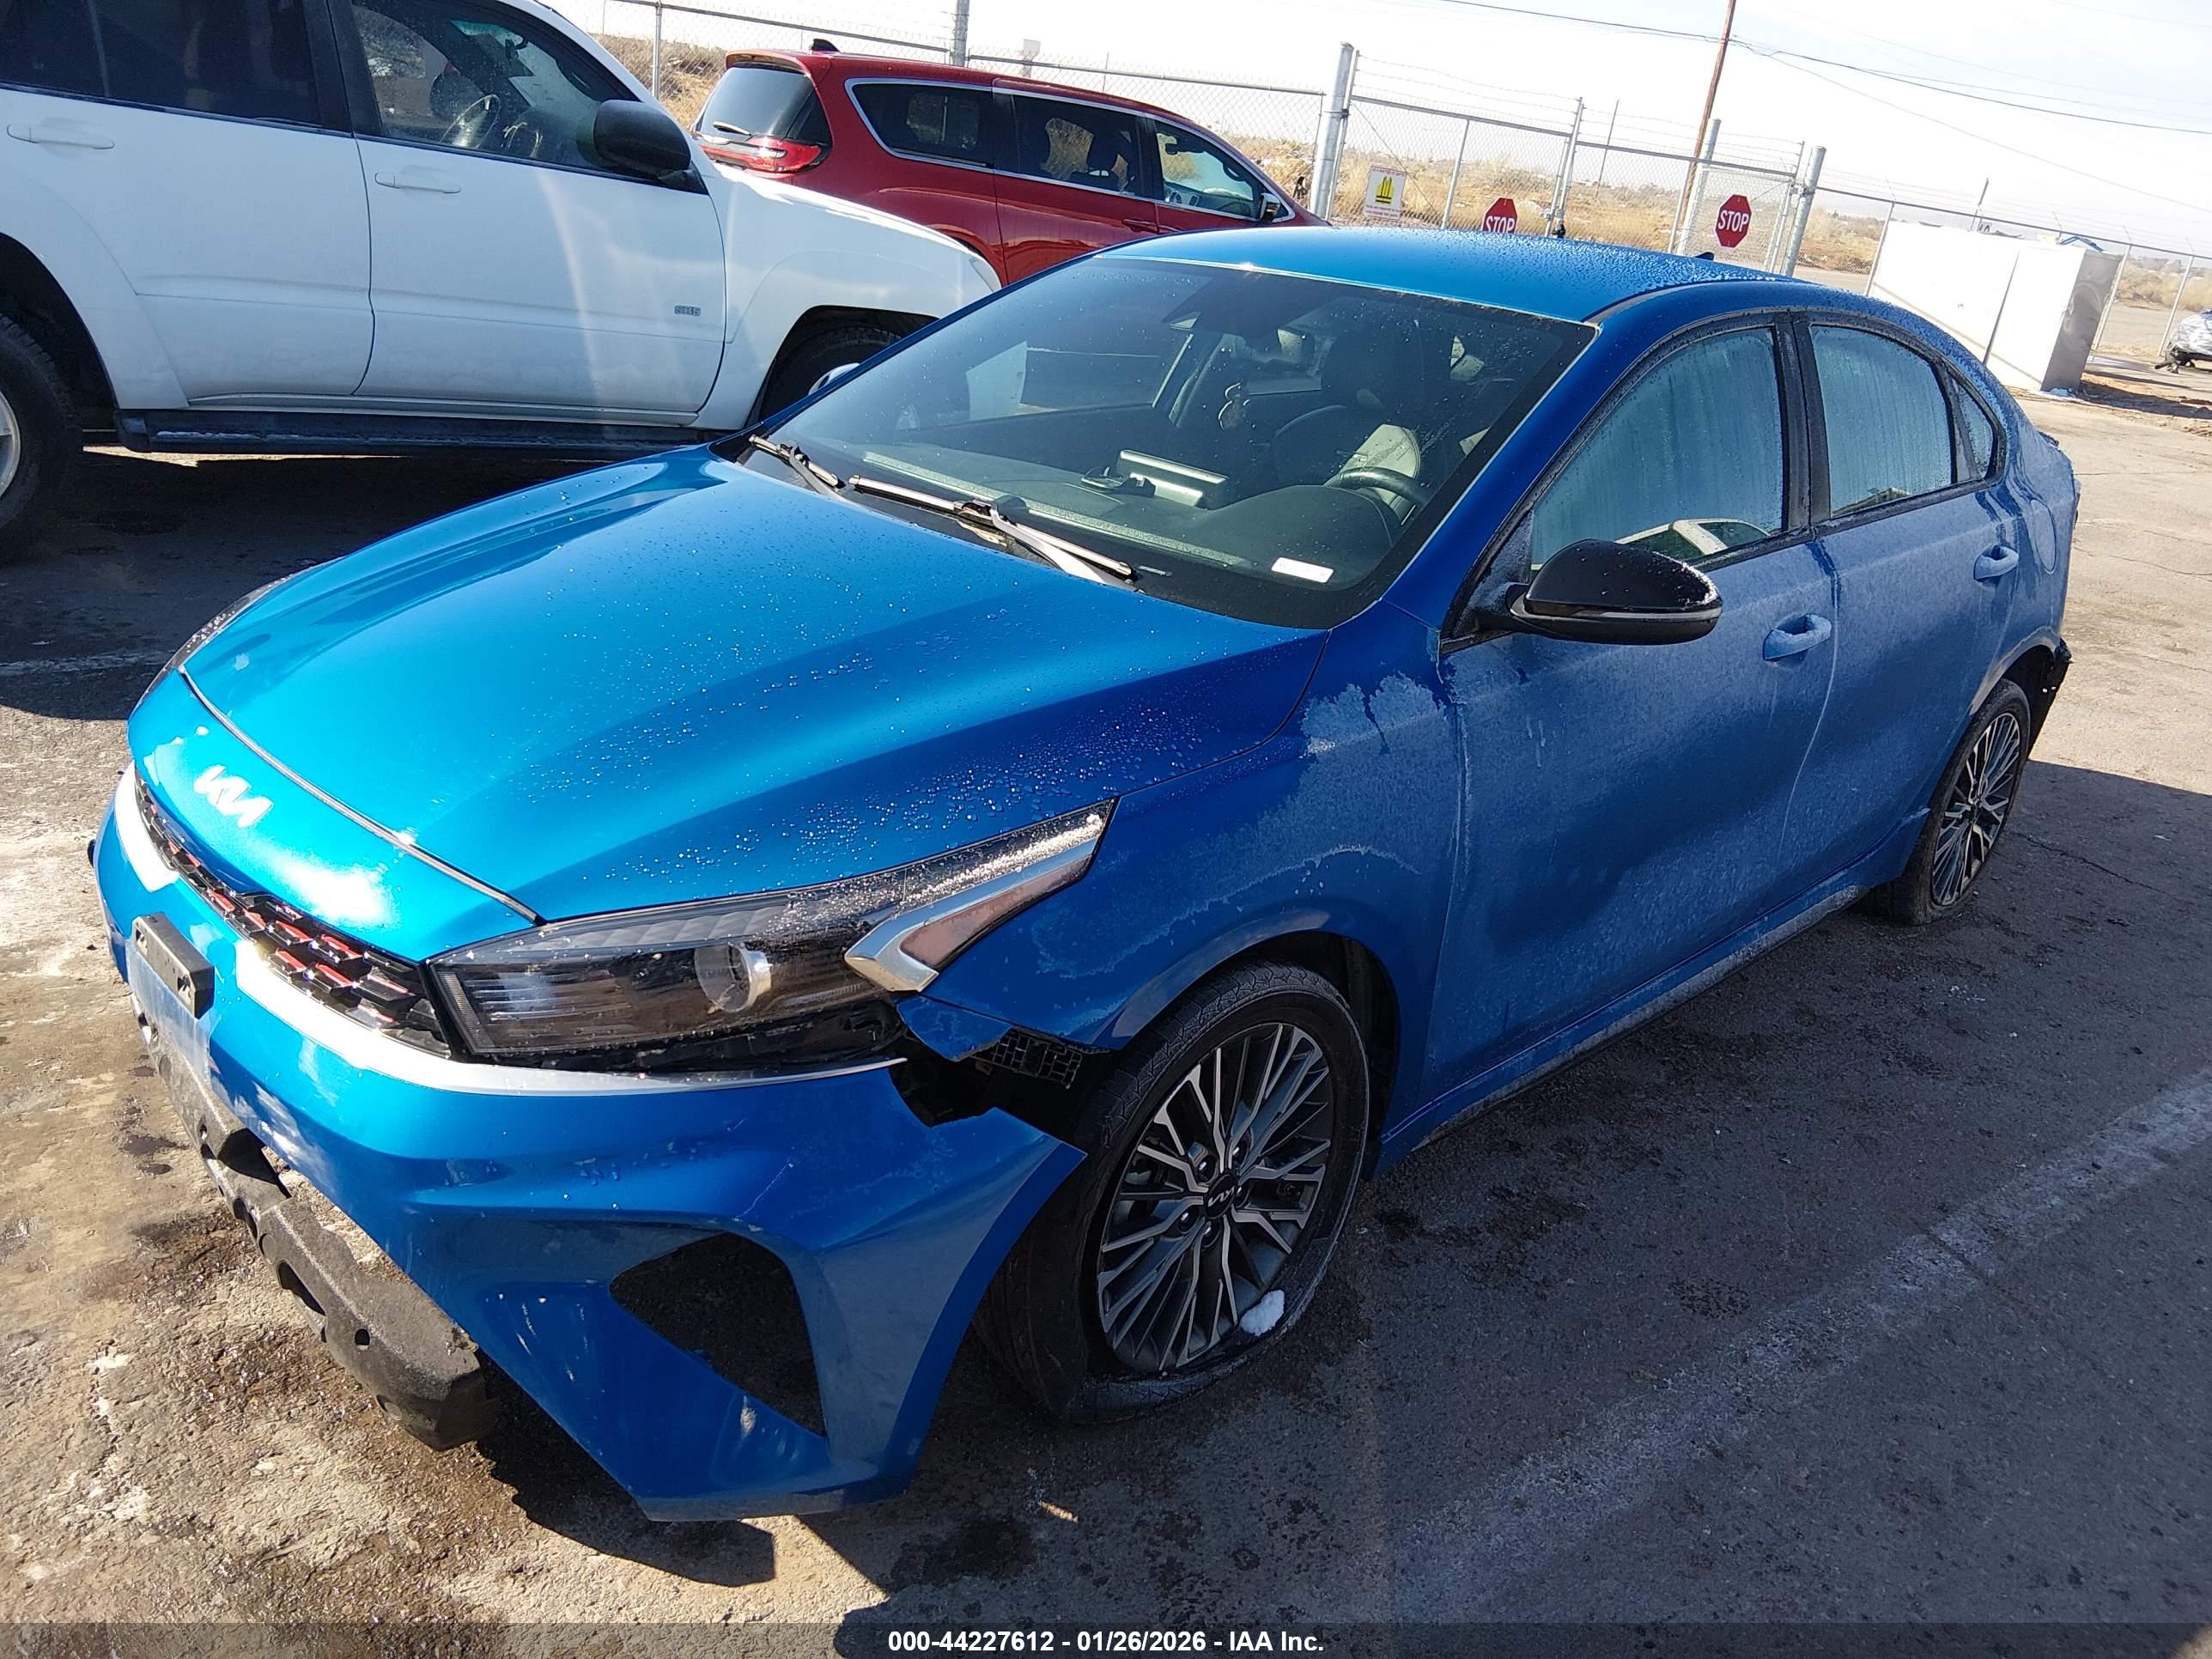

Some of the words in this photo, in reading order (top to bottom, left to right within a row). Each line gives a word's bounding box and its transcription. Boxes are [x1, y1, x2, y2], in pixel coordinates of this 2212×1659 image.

[1486, 216, 1515, 234] STOP
[1717, 210, 1749, 233] STOP
[674, 305, 701, 317] SR5
